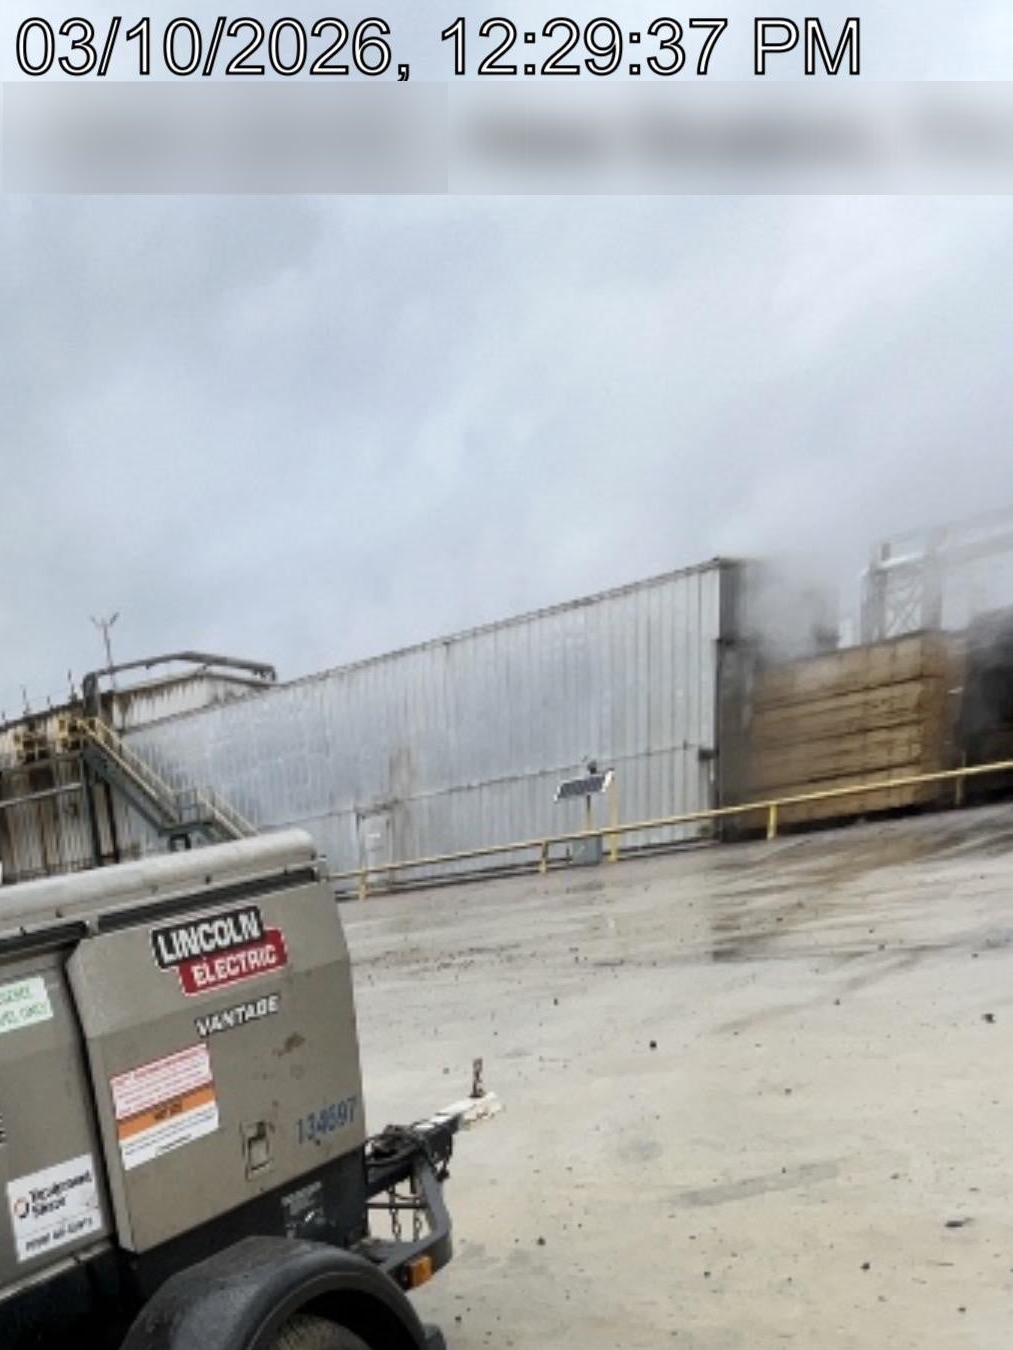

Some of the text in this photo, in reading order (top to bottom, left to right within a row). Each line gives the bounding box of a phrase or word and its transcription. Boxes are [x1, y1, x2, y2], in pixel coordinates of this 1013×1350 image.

[158, 911, 261, 964] LINCOLN
[192, 944, 277, 987] ELECTRIC
[196, 995, 280, 1036] VANTAGE
